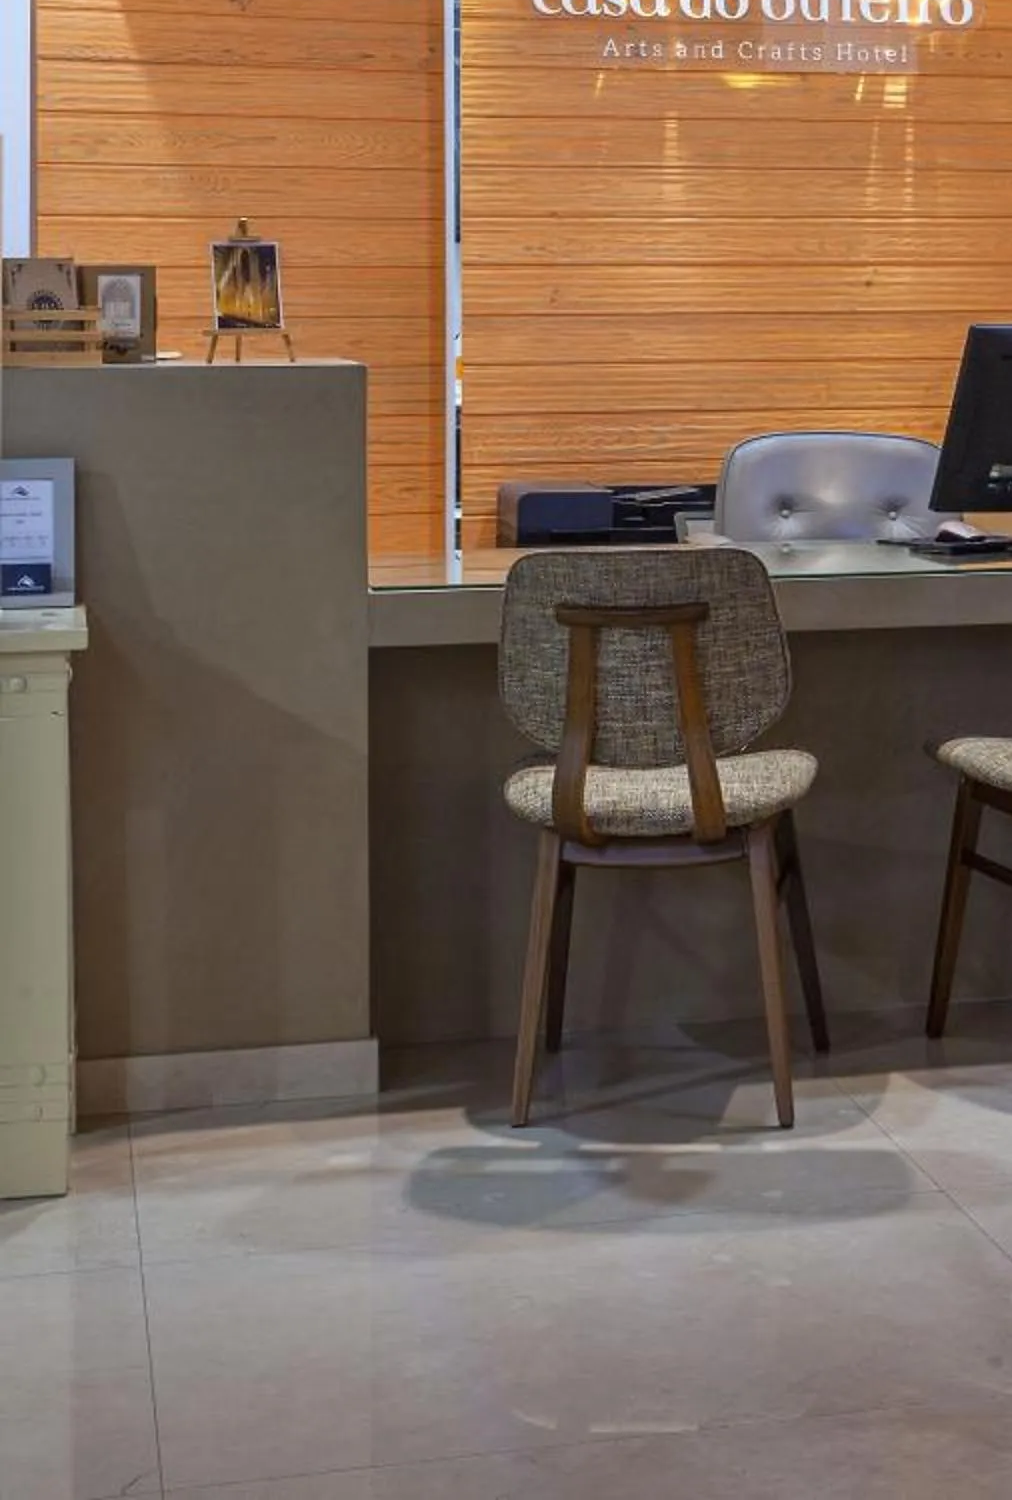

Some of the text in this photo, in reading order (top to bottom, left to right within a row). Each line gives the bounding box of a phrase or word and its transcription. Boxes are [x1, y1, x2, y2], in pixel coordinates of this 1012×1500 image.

[602, 36, 908, 64] Arts and Crafts Hotel
